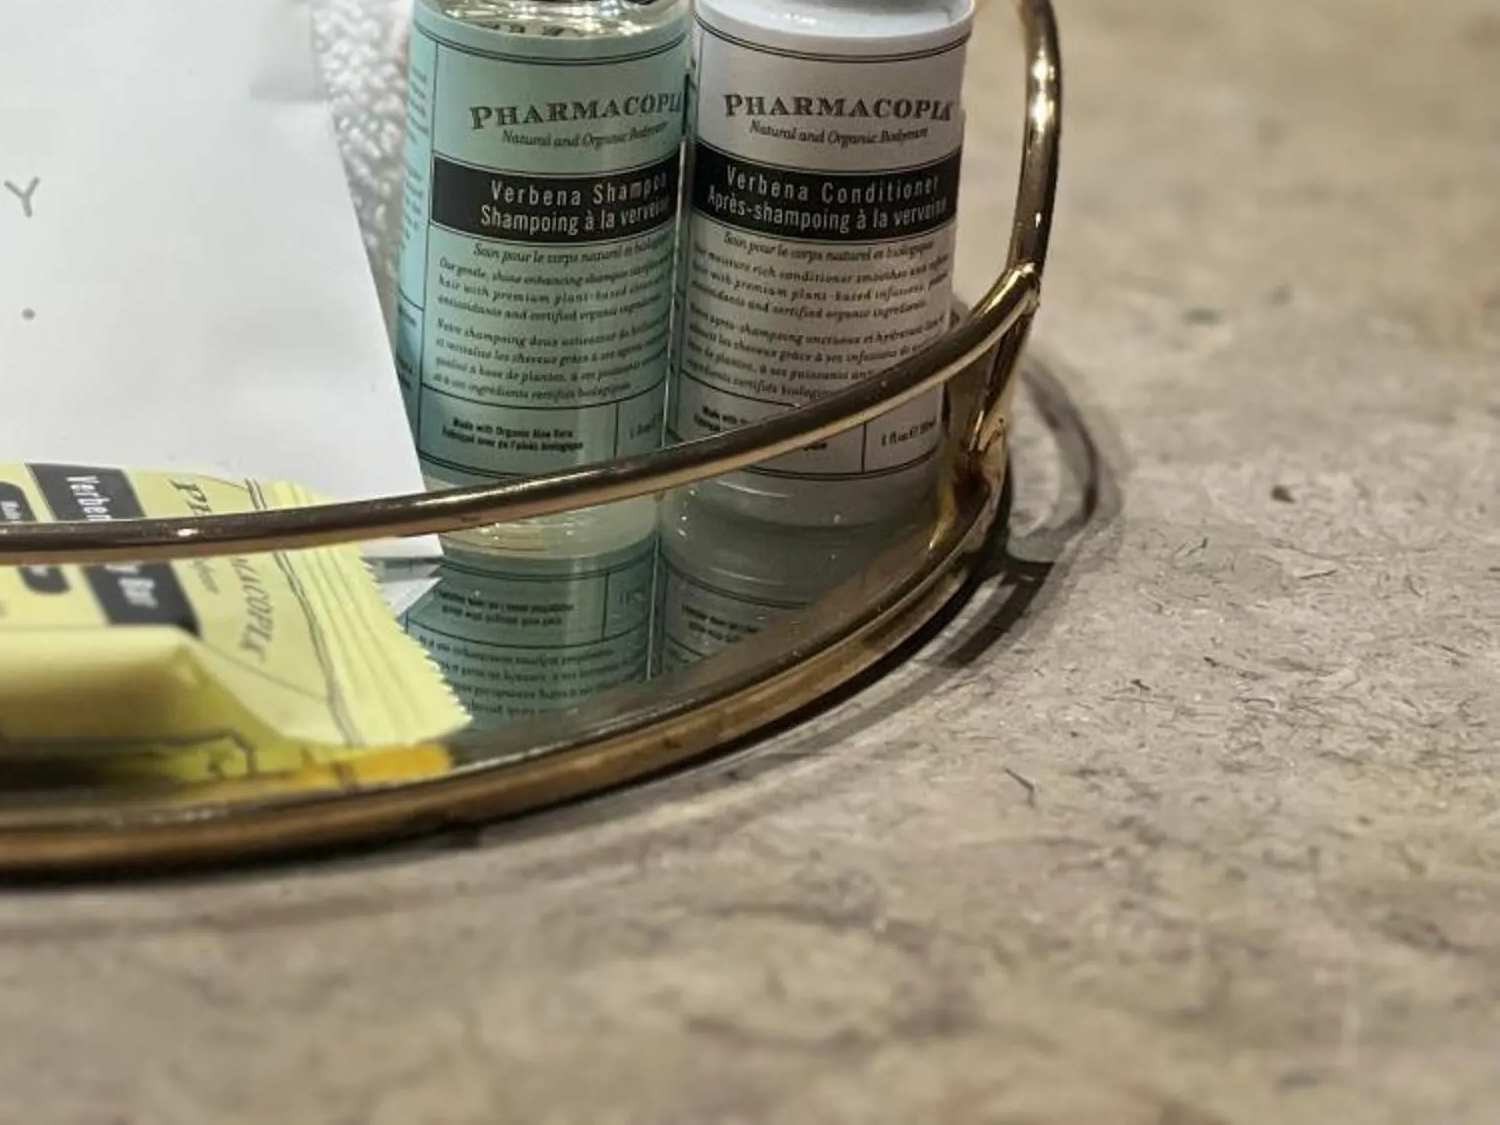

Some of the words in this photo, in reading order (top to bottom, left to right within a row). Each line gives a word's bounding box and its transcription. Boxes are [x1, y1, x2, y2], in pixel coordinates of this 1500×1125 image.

[723, 93, 954, 122] PHARMACOPIA
[553, 131, 580, 148] and
[750, 118, 797, 140] Natural
[799, 129, 825, 144] and
[827, 129, 878, 149] Organic
[491, 179, 582, 206] Verbena
[726, 163, 809, 202] Verbena
[820, 174, 939, 204] Conditioner
[480, 203, 579, 236] Shampoing
[584, 209, 596, 230] à
[601, 208, 615, 230] la
[706, 184, 850, 234] Après-shampoing
[855, 207, 867, 230] à
[872, 207, 888, 229] la
[65, 474, 113, 521] Verben
